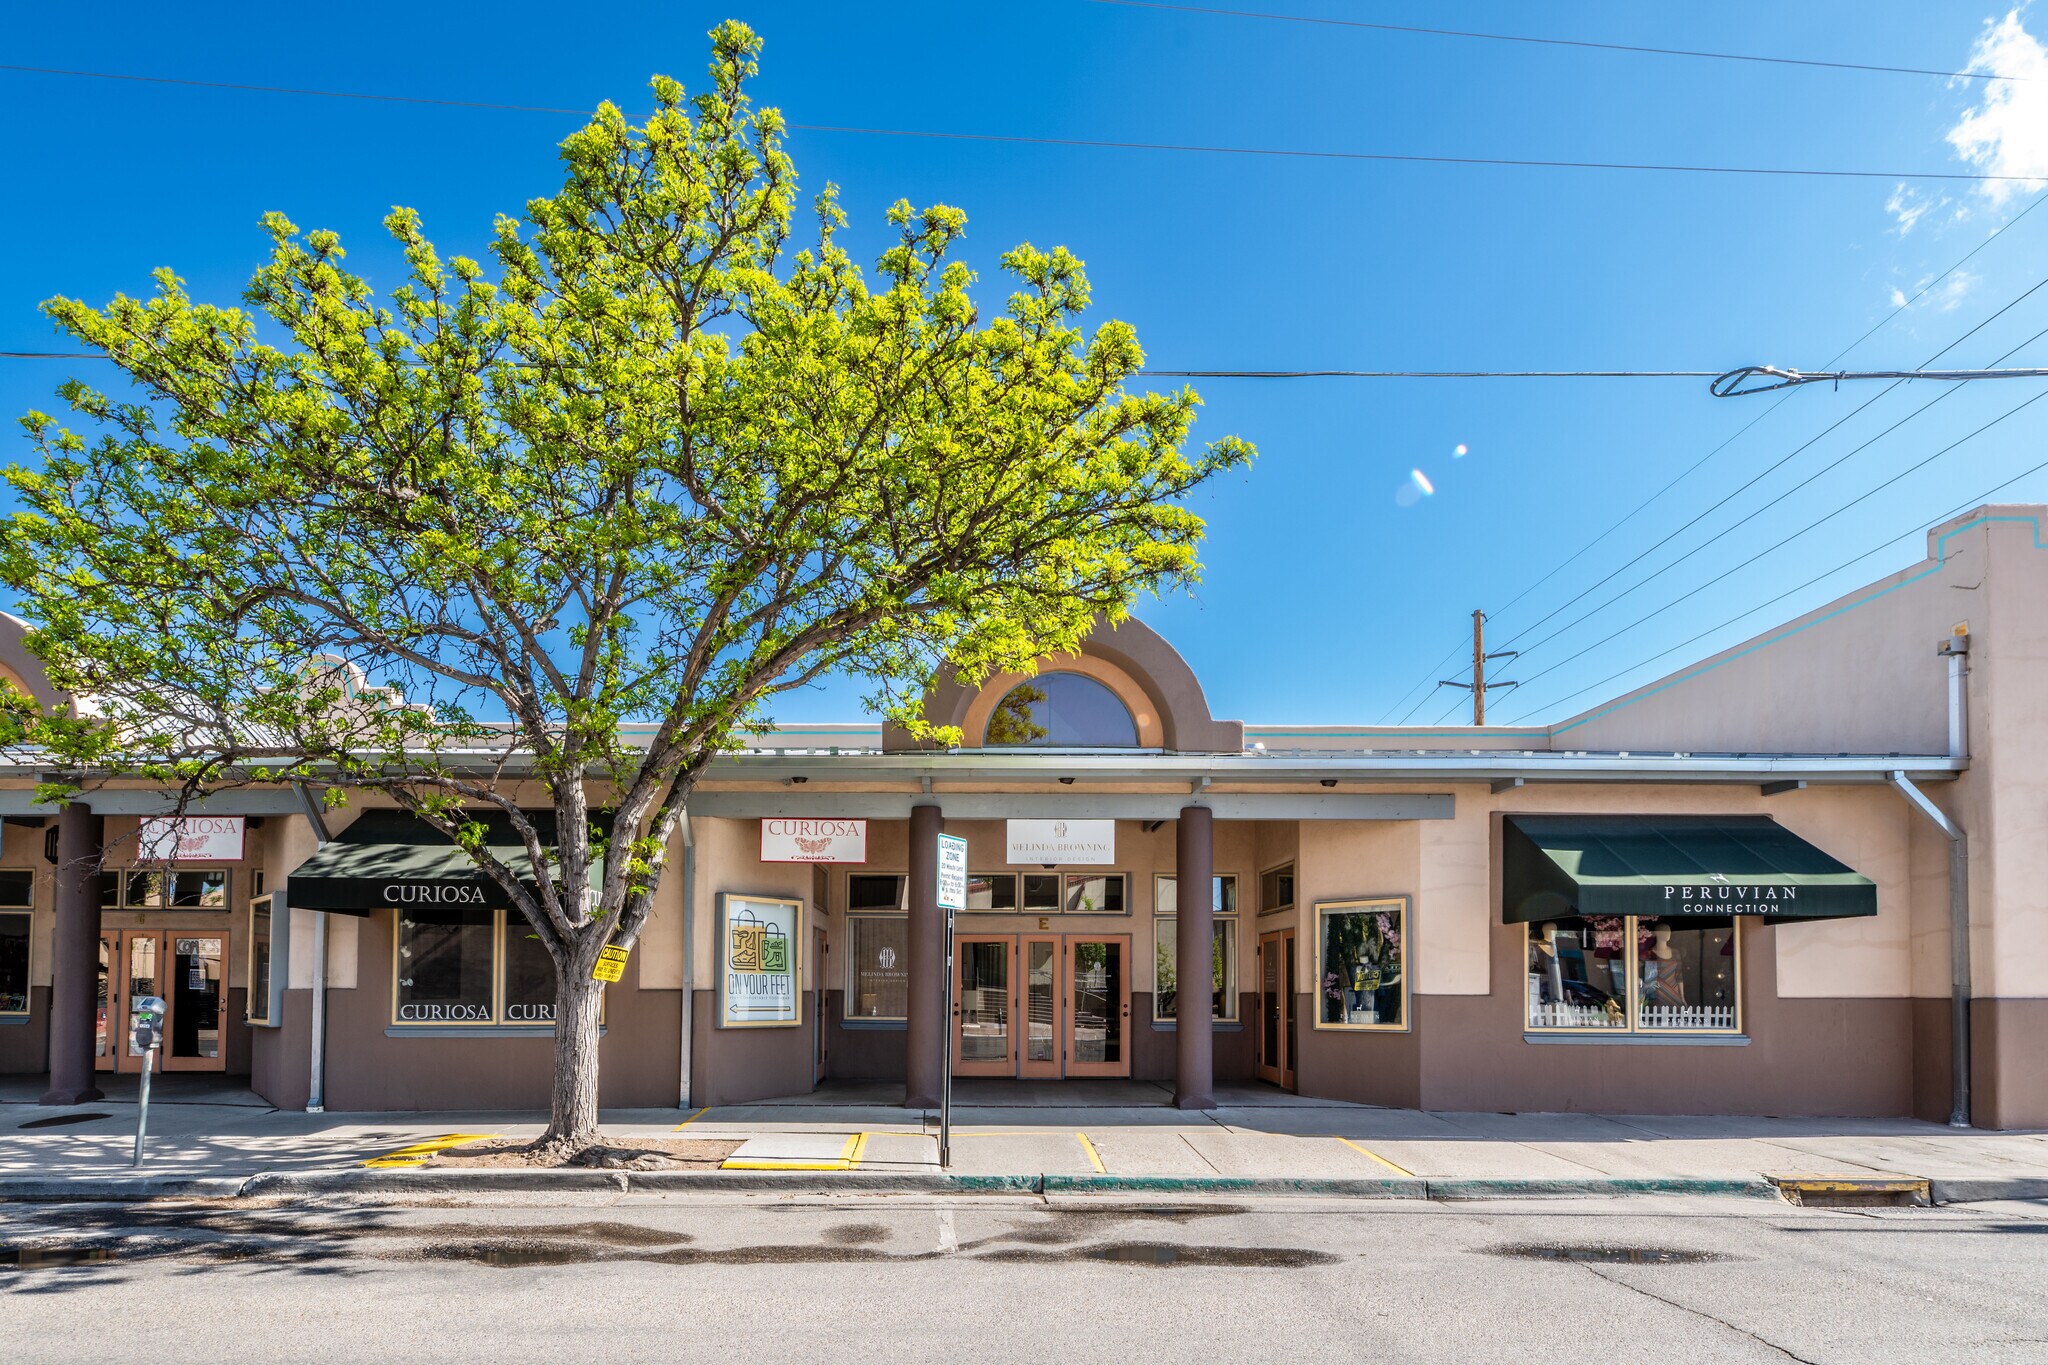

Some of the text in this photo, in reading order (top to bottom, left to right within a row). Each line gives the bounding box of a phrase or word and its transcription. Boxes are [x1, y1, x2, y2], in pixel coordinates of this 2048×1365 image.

[768, 820, 859, 836] CURIOSA
[941, 840, 964, 852] LOADING
[1012, 843, 1110, 851] MELINDA BROWNING
[946, 851, 960, 862] ZONE
[383, 884, 486, 903] CURIOSA
[1664, 886, 1796, 899] PERUVIAN
[1683, 904, 1779, 913] CONNECTION
[1038, 917, 1049, 930] E
[602, 947, 628, 962] CAUTION
[728, 973, 790, 995] ON YOUR FEET
[400, 1004, 490, 1020] CURIOSA
